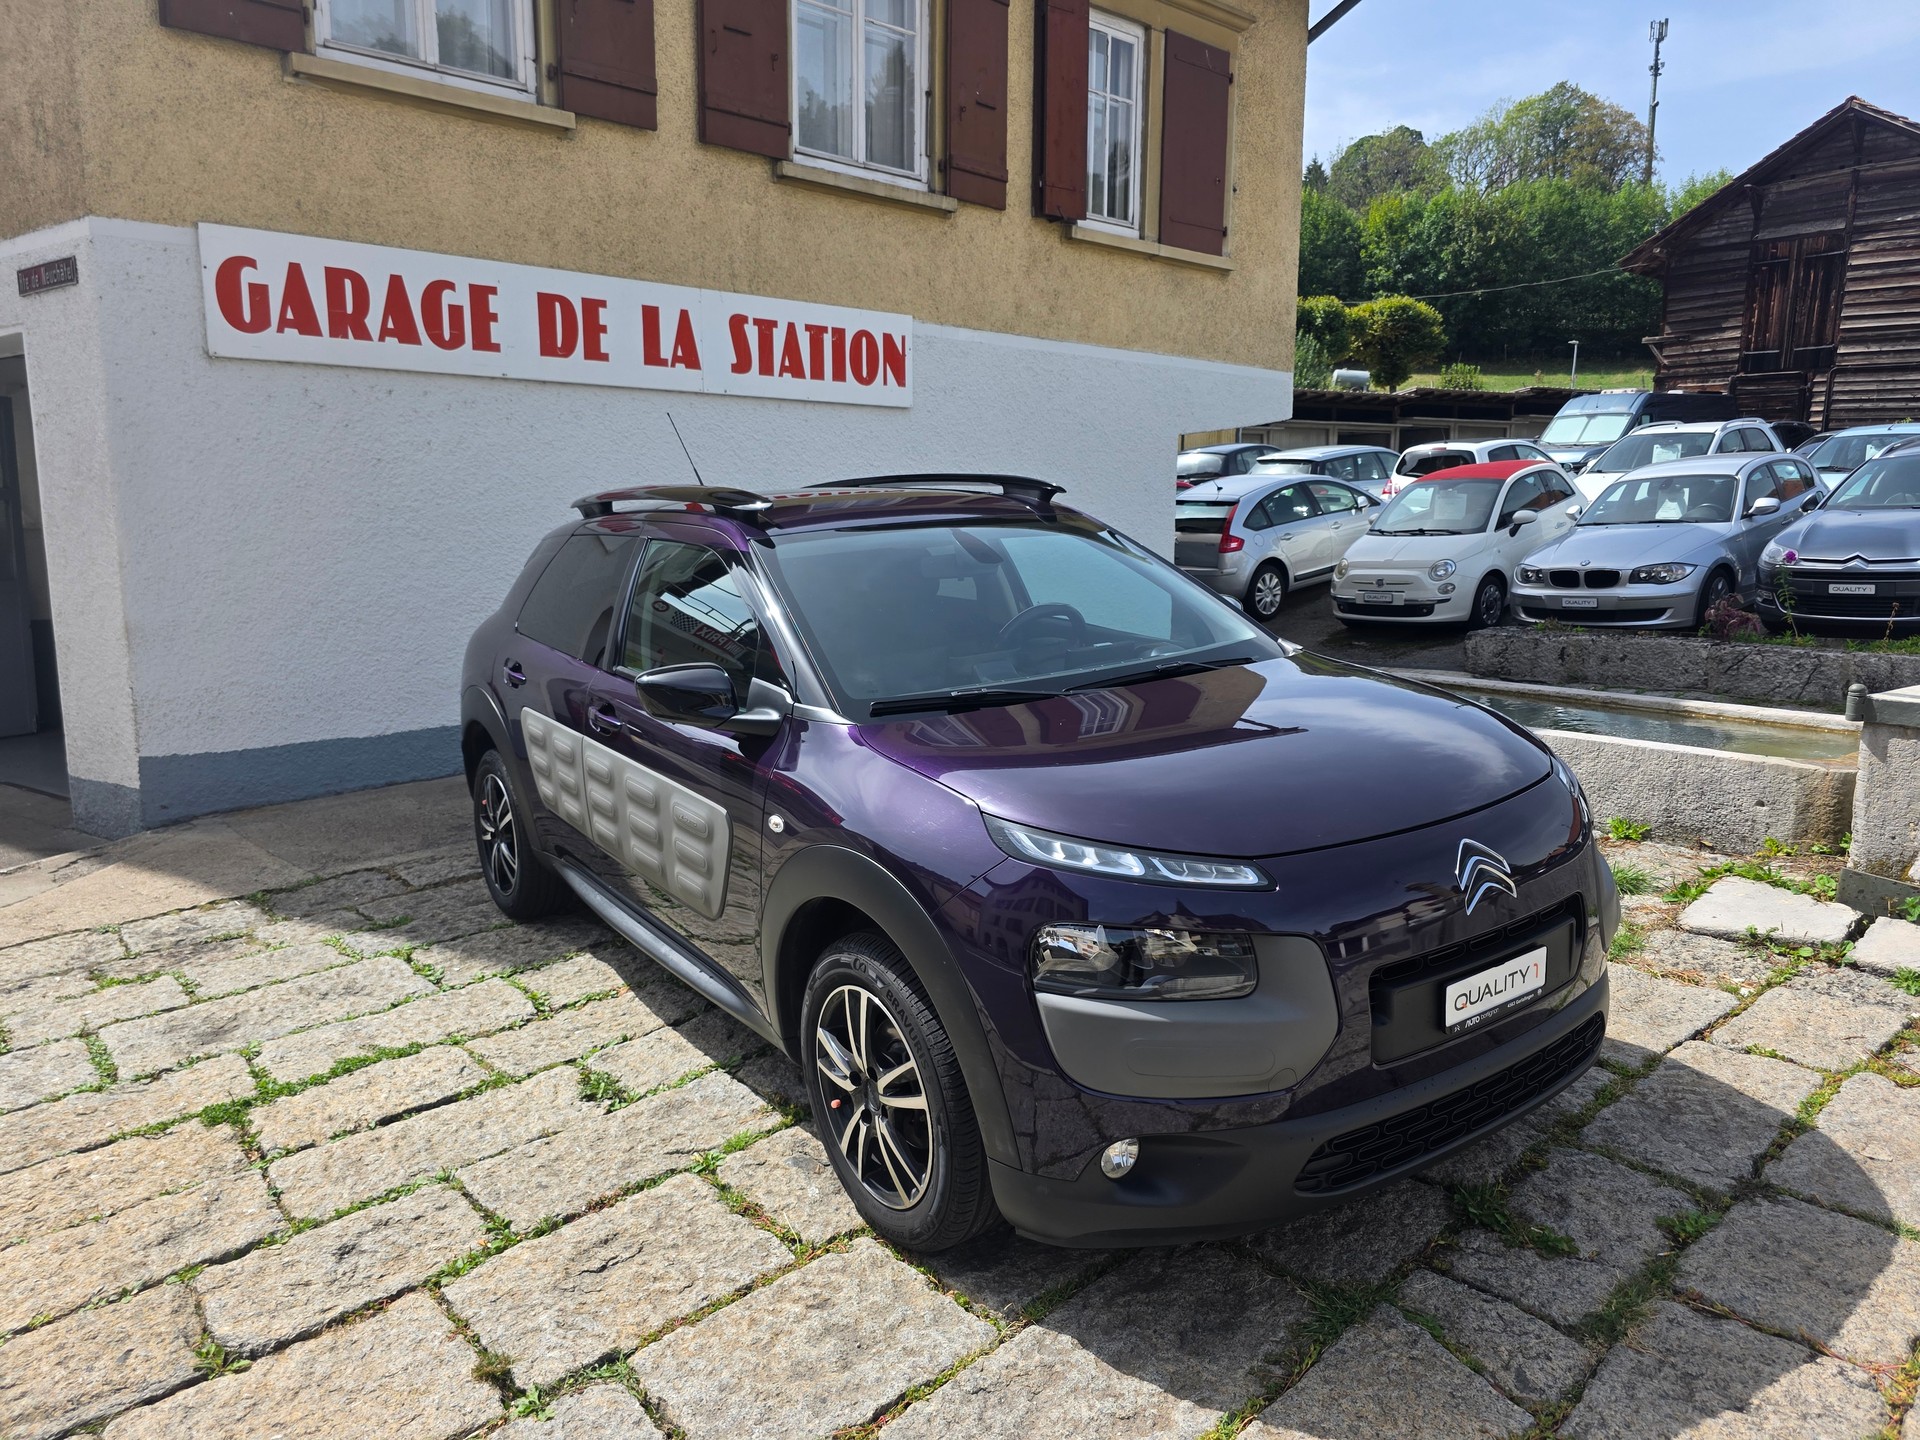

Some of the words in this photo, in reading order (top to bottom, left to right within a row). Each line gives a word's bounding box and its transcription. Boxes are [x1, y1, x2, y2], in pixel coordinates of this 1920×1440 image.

[214, 255, 502, 354] GARAGE
[536, 291, 610, 363] DE
[641, 304, 702, 371] LA
[728, 313, 907, 388] STATION
[1454, 965, 1530, 1012] QUALITY
[1533, 962, 1539, 979] 1
[885, 989, 928, 1070] BRAVURIS
[1464, 1015, 1481, 1029] AUTO
